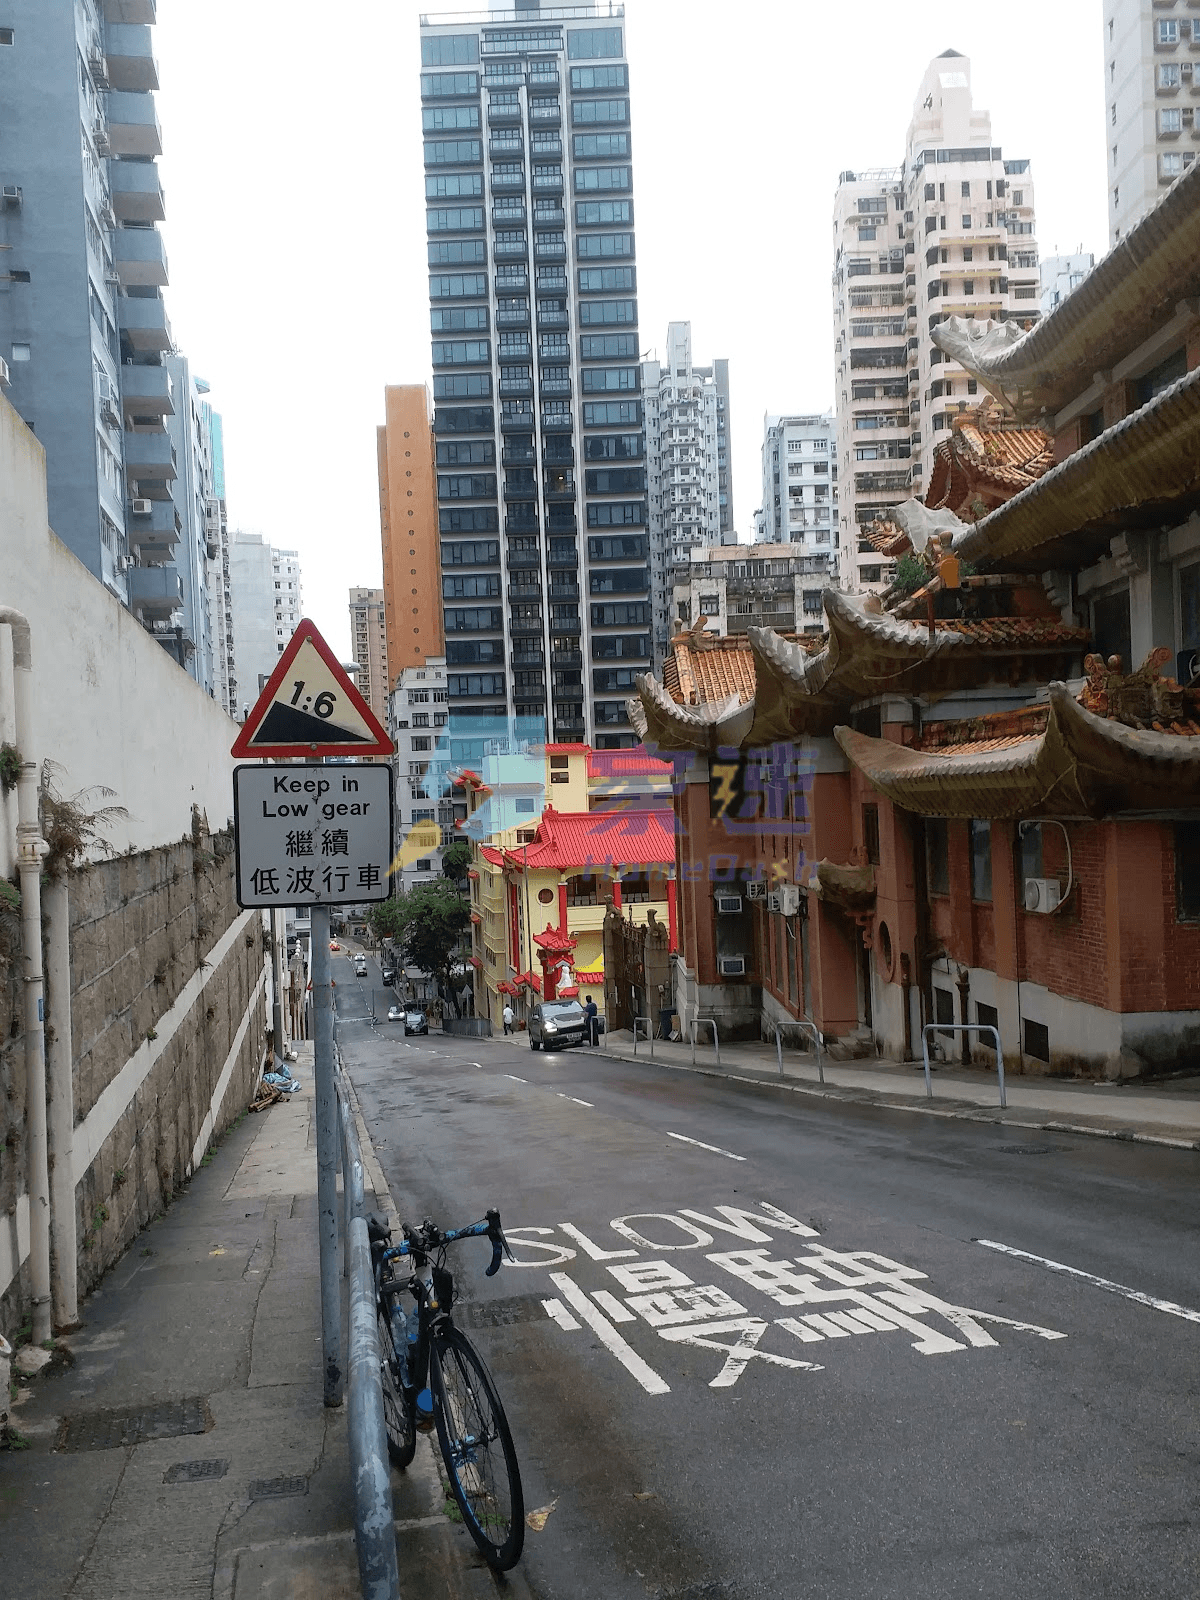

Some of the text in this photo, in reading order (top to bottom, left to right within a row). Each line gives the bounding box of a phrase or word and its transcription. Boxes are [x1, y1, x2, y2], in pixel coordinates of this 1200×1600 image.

[290, 680, 337, 719] 1:6
[273, 775, 359, 798] Keep in
[262, 800, 371, 821] Low gear
[285, 828, 350, 858] 繼續
[249, 863, 382, 896] 低波行車
[499, 1202, 821, 1267] SLOW
[541, 1243, 1068, 1395] 慢駛
